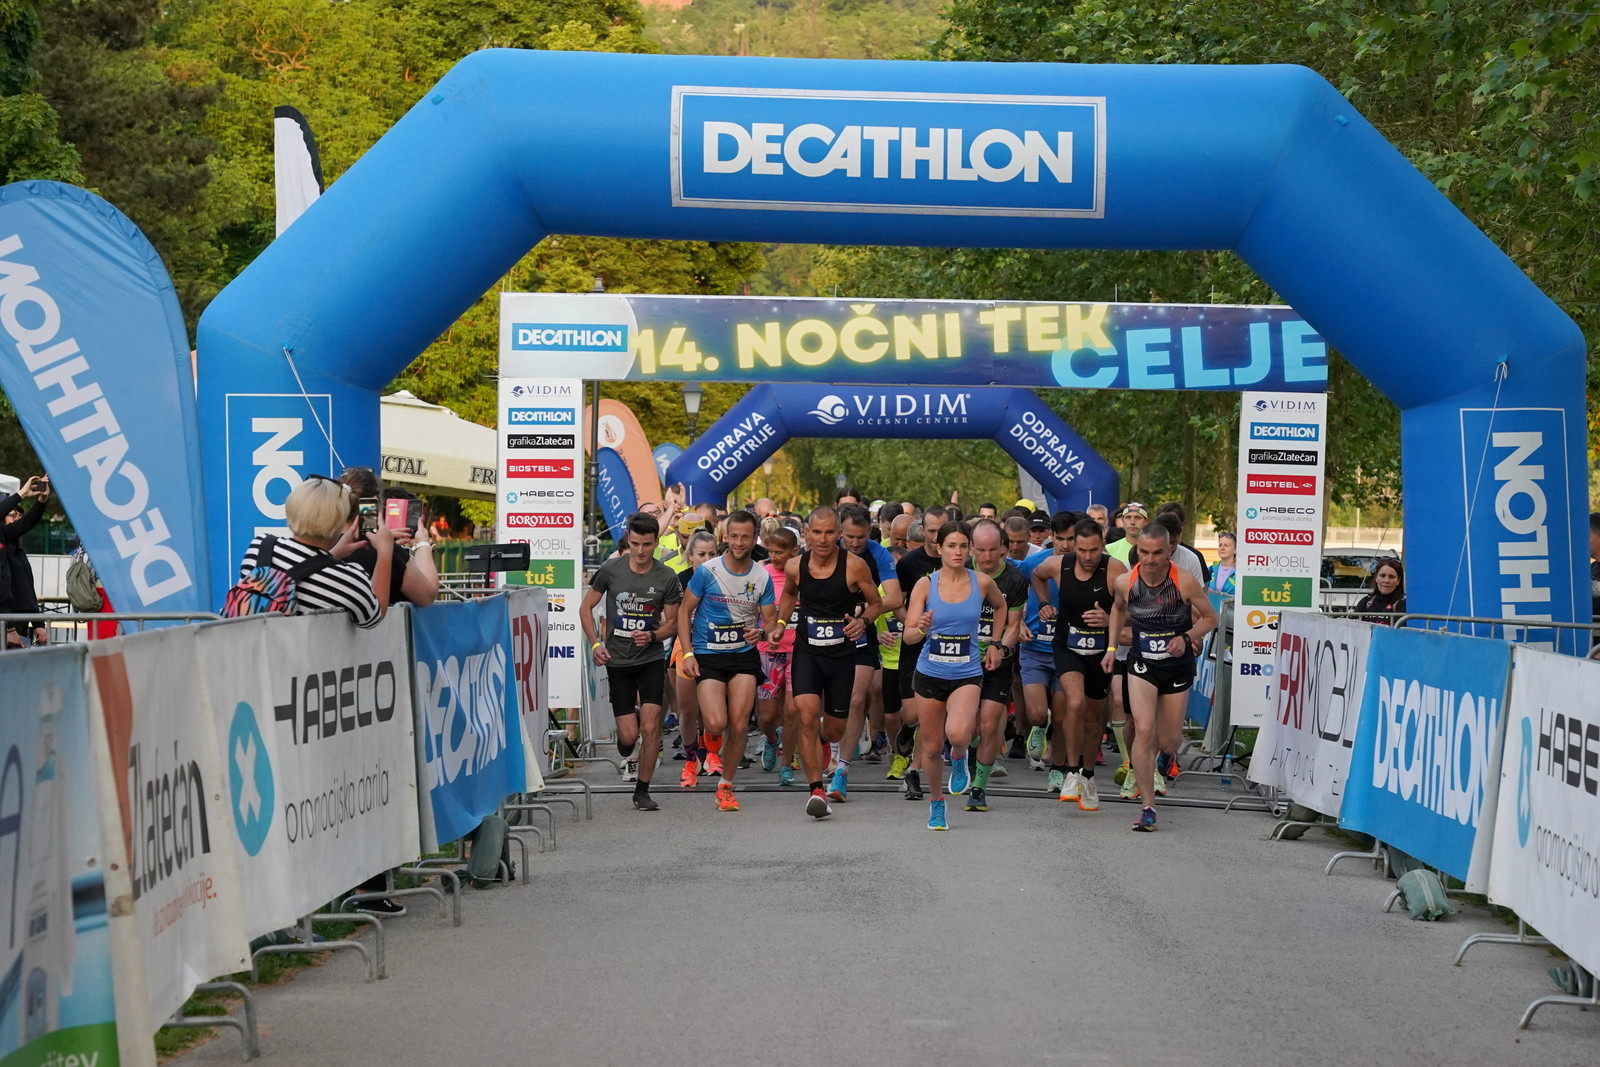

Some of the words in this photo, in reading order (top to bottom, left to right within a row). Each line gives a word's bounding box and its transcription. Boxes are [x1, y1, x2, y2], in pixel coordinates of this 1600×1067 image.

[703, 120, 1074, 184] DECATHLON
[518, 328, 622, 348] DECATHLON
[630, 327, 719, 374] 14.
[737, 303, 962, 370] NOČNI
[979, 303, 1114, 354] TEK
[1050, 320, 1327, 390] CELJE
[527, 385, 571, 395] VIDIM
[853, 393, 968, 417] VIDIM
[1270, 400, 1316, 410] VIDIM
[0, 233, 193, 606] DECATHLON
[511, 411, 572, 422] DECATHLON
[857, 417, 908, 426] OČESNI
[916, 417, 968, 425] CENTER
[1253, 425, 1316, 438] DECATHLON
[697, 411, 766, 470] ODPRAVA
[1022, 411, 1085, 475] ODPRAVA
[708, 423, 776, 482] DIOPTRIJE
[1009, 423, 1075, 486] DIOPTRIJE
[252, 417, 304, 537] ON
[469, 464, 496, 485] FR
[1249, 480, 1300, 489] BIOSTEEL
[519, 490, 575, 498] HABECO
[1259, 506, 1316, 514] HABECO
[508, 515, 573, 527] BOROTALCO
[1247, 531, 1312, 543] BOROTALCO
[1247, 555, 1309, 568] FRIMOBIL
[548, 622, 575, 631] alnica
[622, 617, 646, 630] 150
[714, 630, 738, 643] 149
[816, 625, 834, 638] 26
[939, 641, 961, 655] 121
[1077, 637, 1096, 649] 49
[1149, 639, 1166, 652] 92
[549, 646, 575, 659] INE
[273, 660, 396, 745] HABECO
